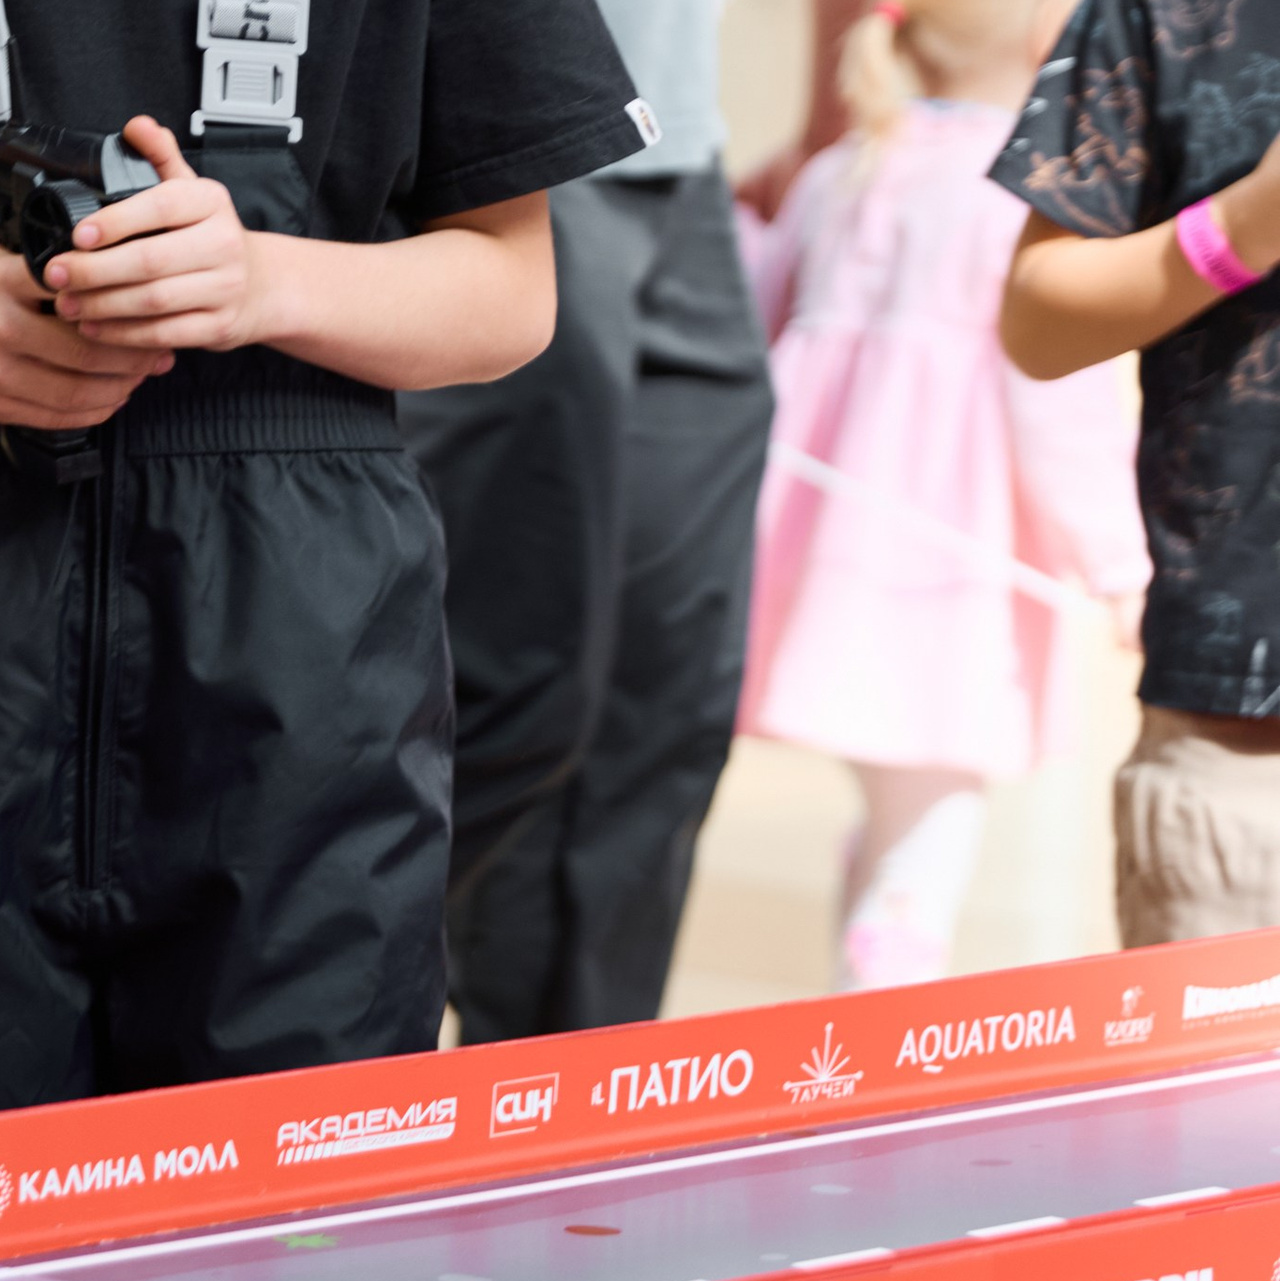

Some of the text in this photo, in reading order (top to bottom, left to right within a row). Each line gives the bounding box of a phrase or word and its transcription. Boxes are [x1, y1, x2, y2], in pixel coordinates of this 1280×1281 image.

[895, 1005, 1077, 1074] AQUATORIA
[607, 1048, 755, 1115] ПАТИО
[276, 1096, 459, 1148] АКАДЕМИЯ
[18, 1138, 240, 1204] КАЛИНА МОЛЛ
